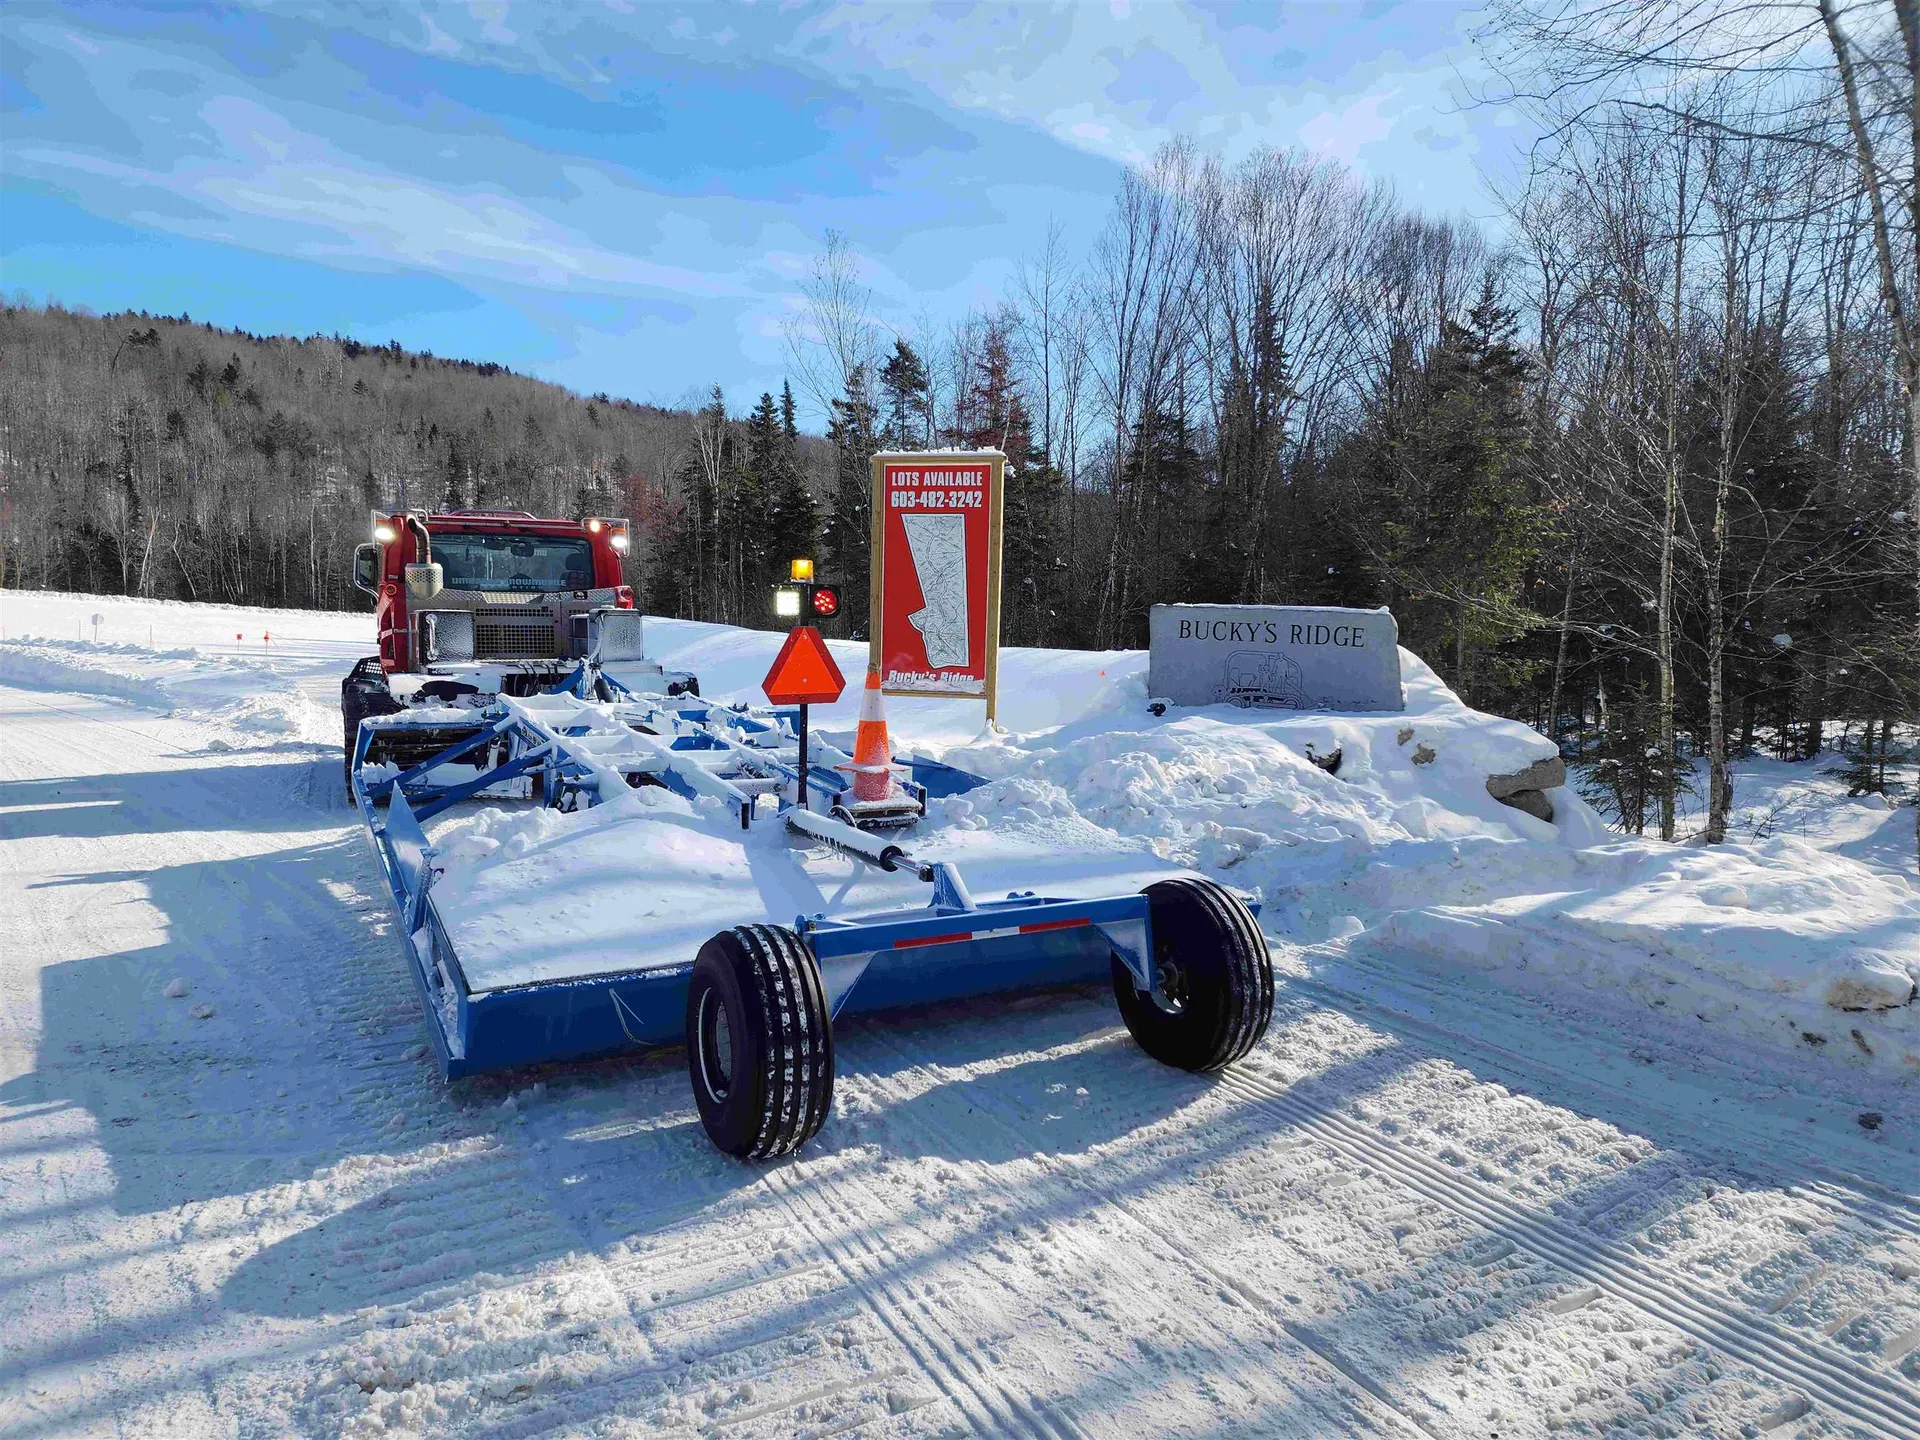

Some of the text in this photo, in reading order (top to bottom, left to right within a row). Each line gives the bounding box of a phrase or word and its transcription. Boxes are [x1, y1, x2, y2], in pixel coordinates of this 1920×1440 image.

[891, 472, 982, 486] LOTS AVAILABLE
[891, 491, 982, 508] 603-482-3242
[1178, 619, 1365, 648] BUCKY'S RIDGE
